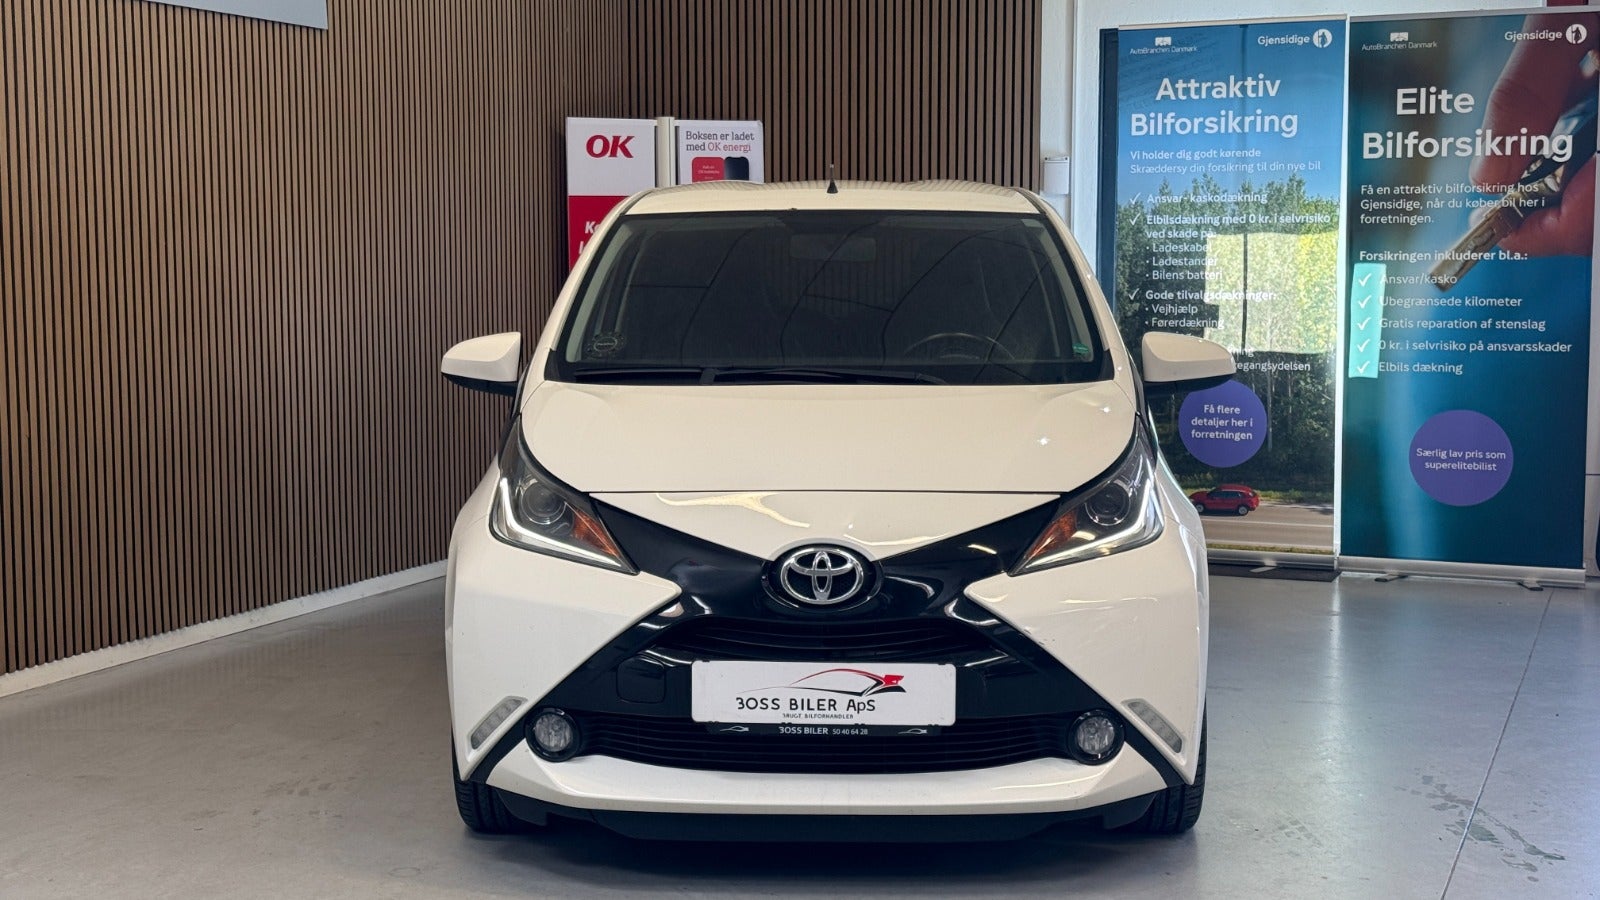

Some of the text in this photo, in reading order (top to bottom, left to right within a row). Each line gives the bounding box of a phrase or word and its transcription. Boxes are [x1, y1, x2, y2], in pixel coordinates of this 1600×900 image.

[1258, 35, 1310, 47] Gjensidige
[1504, 30, 1562, 42] Gjensidige
[1362, 41, 1438, 51] AutoBranchen Danmark
[1156, 74, 1280, 100] Attraktiv
[1396, 86, 1475, 116] Elite
[1131, 109, 1298, 138] Bilforsikring
[686, 131, 755, 141] Boksen er ladet
[586, 134, 634, 158] OK
[686, 142, 752, 154] med OK energi
[1363, 128, 1573, 163] Bilforsikring
[1130, 148, 1261, 162] Vi holder dig godt kørende
[1130, 160, 1321, 175] Skræddersy din forsikring til din nye bil
[1361, 183, 1539, 196] Få en attraktiv bilforsikring hos
[1190, 192, 1268, 204] kaskodækning
[1360, 198, 1545, 211] Gjensidige, når du køber bil her i
[1146, 214, 1330, 226] Elbilsdækning med 0 kr. i selvrisiko
[1360, 214, 1434, 226] forretningen.
[1146, 230, 1164, 238] ved
[1167, 229, 1198, 238] skade
[1152, 243, 1212, 252] Ladeskabel
[1152, 256, 1218, 266] Ladestander
[1359, 250, 1528, 264] Forsikringen inkluderer bl.a.:
[1152, 270, 1222, 280] Bilens batteri
[1380, 273, 1458, 285] Ansvar/kasko
[1146, 290, 1174, 300] Gode
[1379, 296, 1522, 308] Ubegrænsede kilometer
[1152, 304, 1198, 316] Vejhjælp
[1152, 318, 1224, 330] Førerdækning
[1380, 318, 1546, 332] Gratis reparation af stenslag
[1379, 340, 1572, 353] 0 kr. i selvrisiko på ansvarsskader
[1379, 362, 1464, 374] Elbils dækning
[1204, 404, 1240, 414] Få flere
[1191, 417, 1253, 428] detaljer her i
[1191, 429, 1252, 441] forretningen
[1416, 448, 1506, 460] Særlig lav pris som
[1424, 461, 1497, 471] superelitebilist
[790, 698, 837, 712] BILER
[846, 699, 876, 714] ApS
[804, 727, 828, 735] BILER
